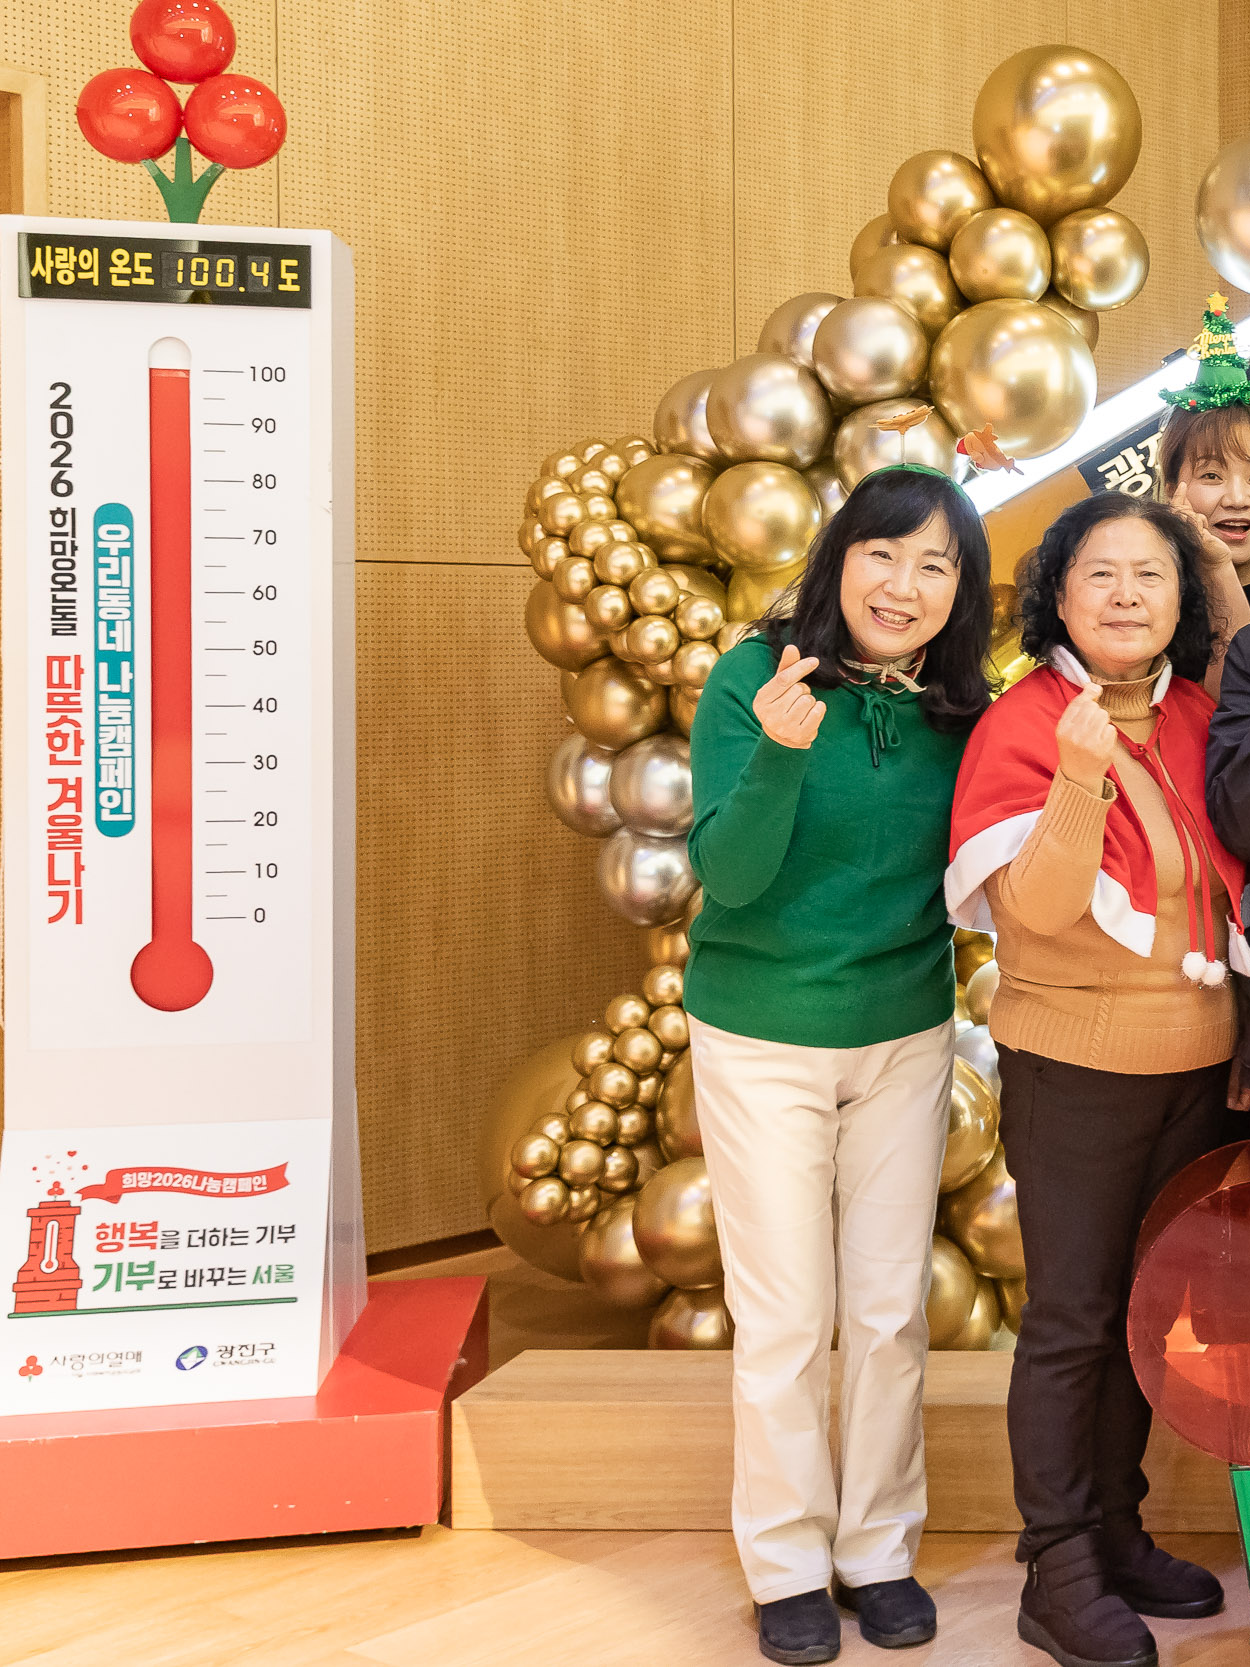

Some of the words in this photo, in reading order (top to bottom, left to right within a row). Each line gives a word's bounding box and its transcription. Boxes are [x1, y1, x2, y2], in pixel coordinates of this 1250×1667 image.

[30, 246, 99, 286] 사랑의
[109, 249, 154, 286] 온도
[177, 257, 269, 292] 100.4
[278, 259, 300, 291] 도
[250, 366, 286, 382] 100
[251, 418, 276, 433] 90
[49, 382, 74, 497] 2026
[252, 474, 277, 489] 80
[253, 530, 277, 545] 70
[49, 507, 78, 636] 희망온돌
[97, 524, 132, 652] 우리동네
[253, 585, 277, 600] 60
[253, 640, 277, 655] 50
[46, 655, 84, 765] 따뜻한
[253, 698, 277, 713] 40
[98, 661, 133, 821] 나눔캠페인
[253, 755, 277, 770] 30
[254, 811, 278, 826] 20
[47, 777, 85, 924] 겨울나기
[255, 863, 278, 878] 10
[254, 908, 266, 923] 0
[96, 1221, 179, 1253] 행복을
[187, 1227, 249, 1248] 더하는
[256, 1225, 296, 1245] 기부
[92, 1261, 177, 1292] 기부로
[185, 1267, 247, 1288] 바꾸는
[252, 1264, 294, 1285] 서울
[216, 1342, 275, 1359] 광진구
